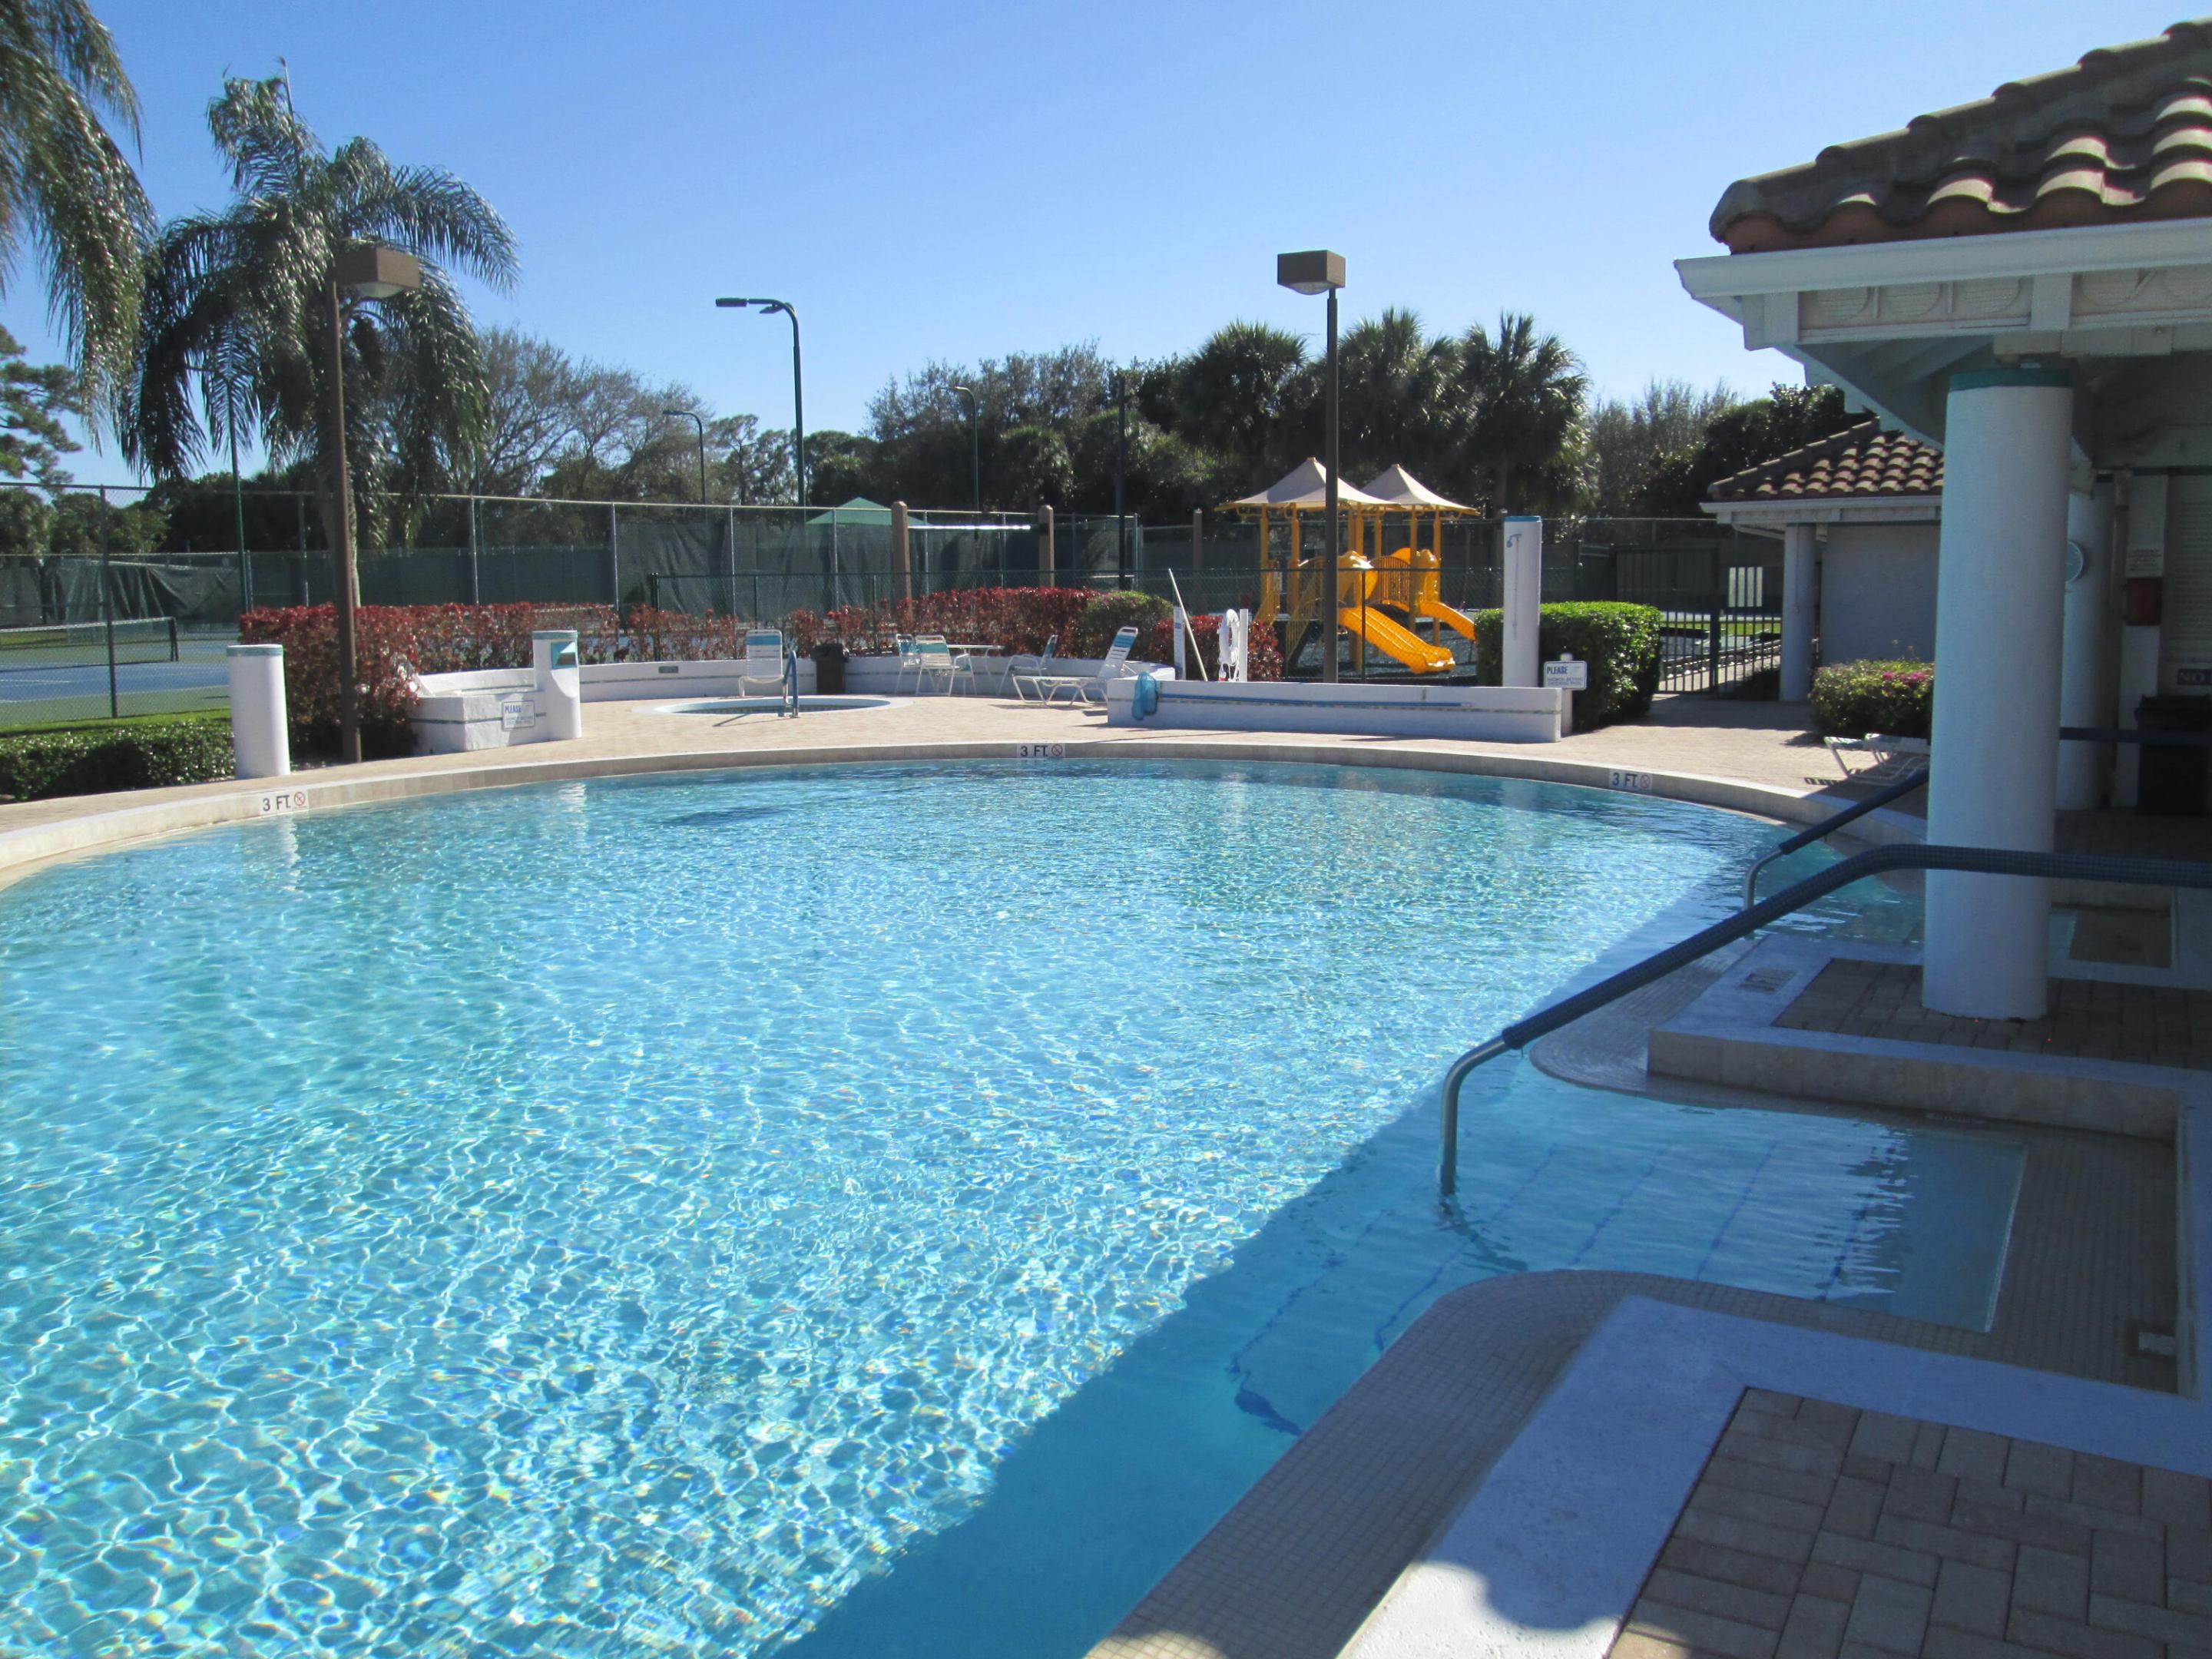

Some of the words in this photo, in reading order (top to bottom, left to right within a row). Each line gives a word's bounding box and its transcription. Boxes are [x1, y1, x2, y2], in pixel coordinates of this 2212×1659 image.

[2181, 672, 2205, 683] NO
[1021, 746, 1028, 757] 3
[1612, 773, 1620, 786] 3
[263, 797, 270, 811] 3
